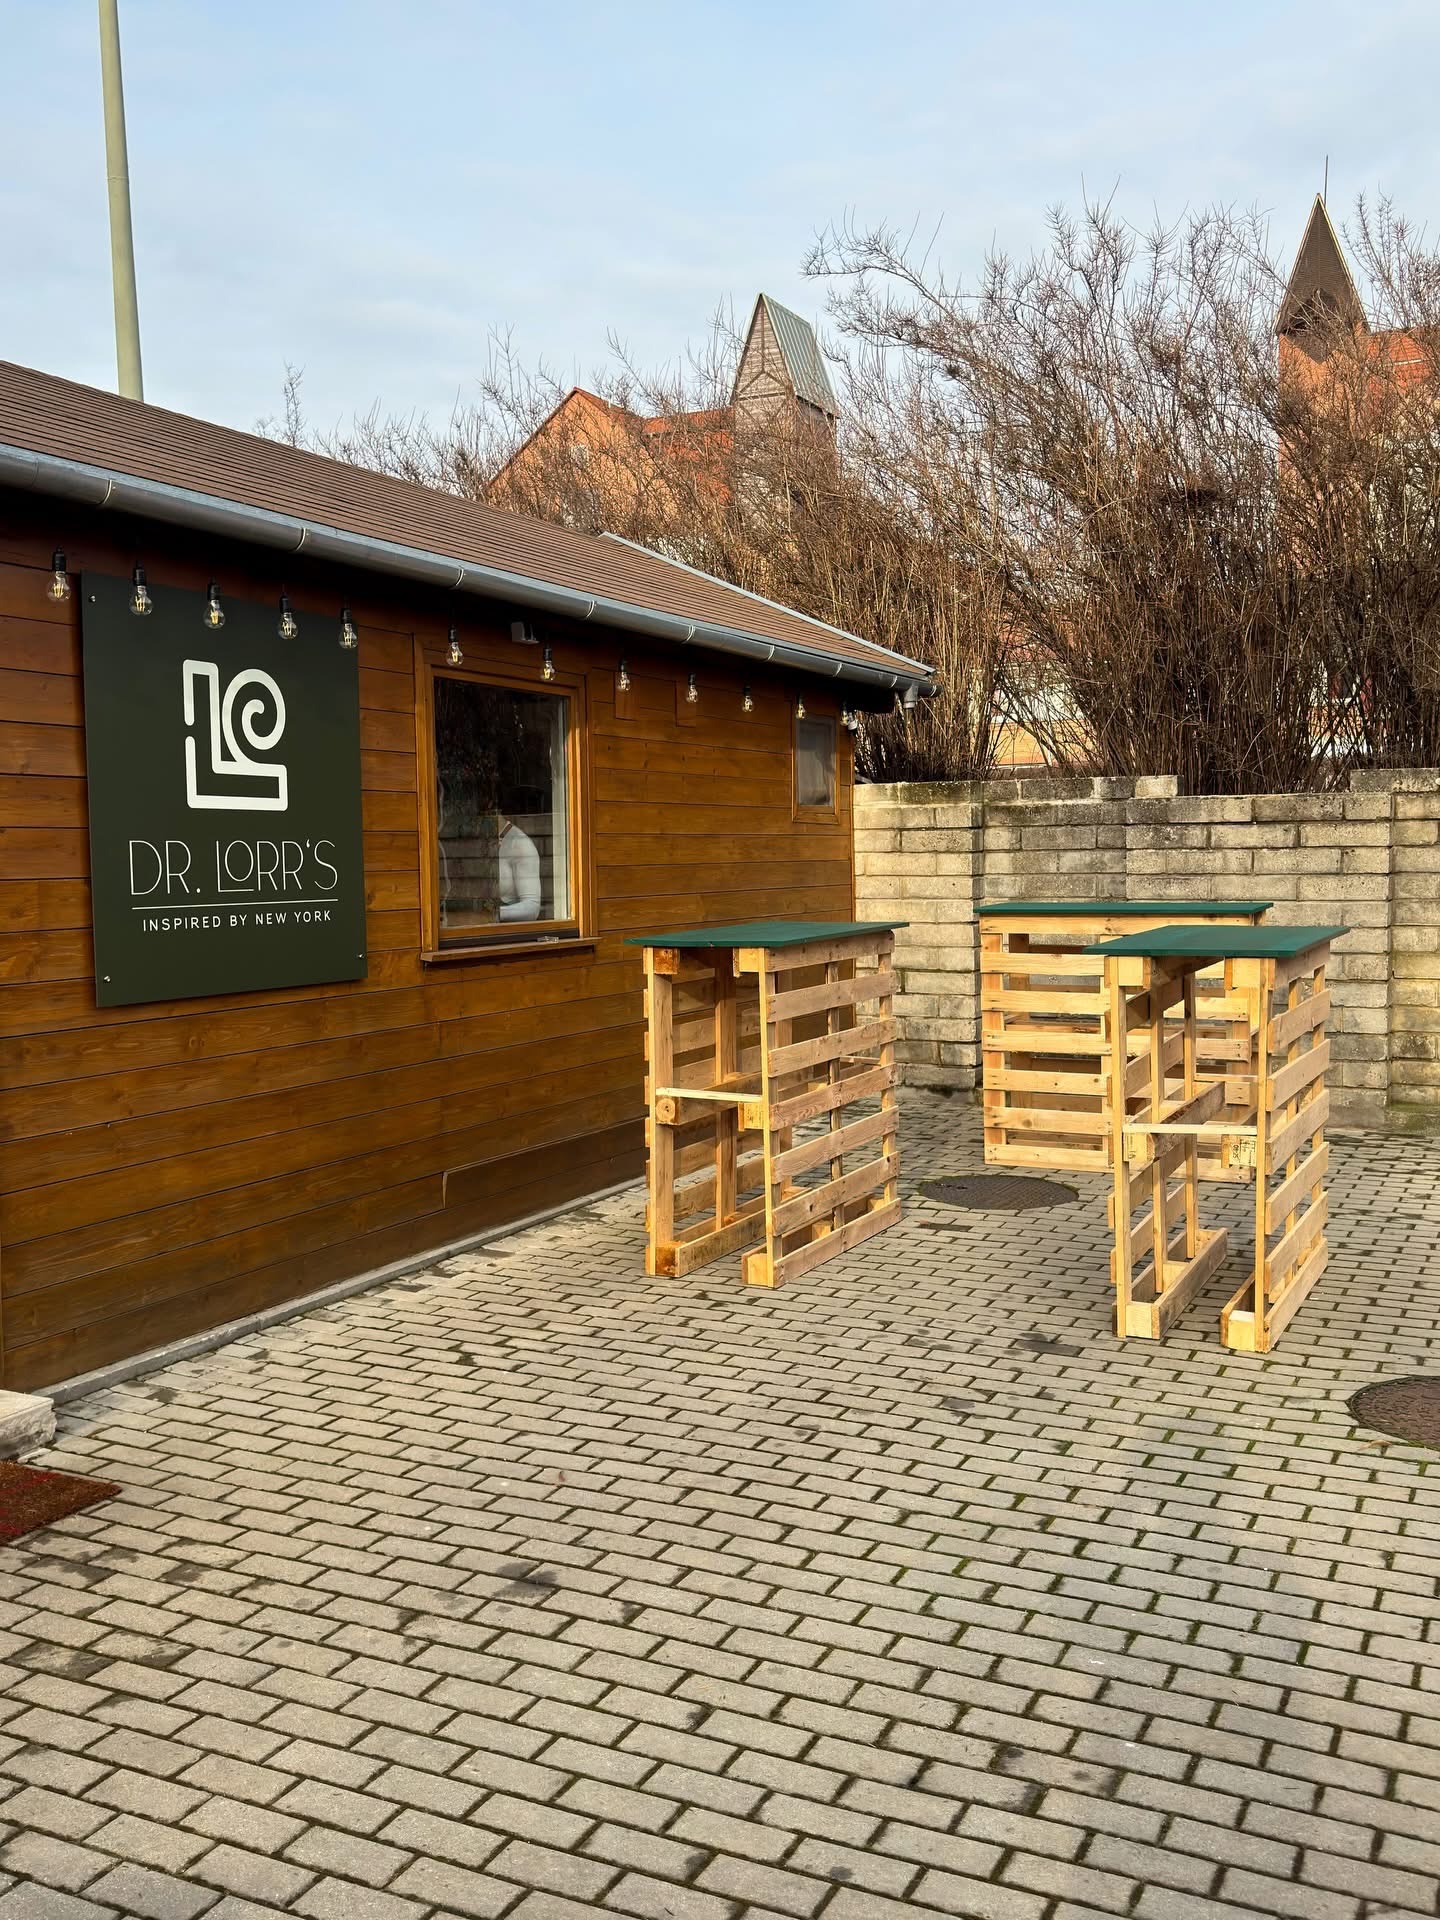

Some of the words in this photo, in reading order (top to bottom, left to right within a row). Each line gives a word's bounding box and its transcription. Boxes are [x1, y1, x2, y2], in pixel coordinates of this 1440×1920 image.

[129, 840, 201, 895] DR.
[216, 839, 338, 893] LORR'S
[142, 915, 221, 932] INSPIRED
[230, 914, 248, 927] BY
[255, 912, 287, 925] NEW
[294, 910, 331, 923] YORK
